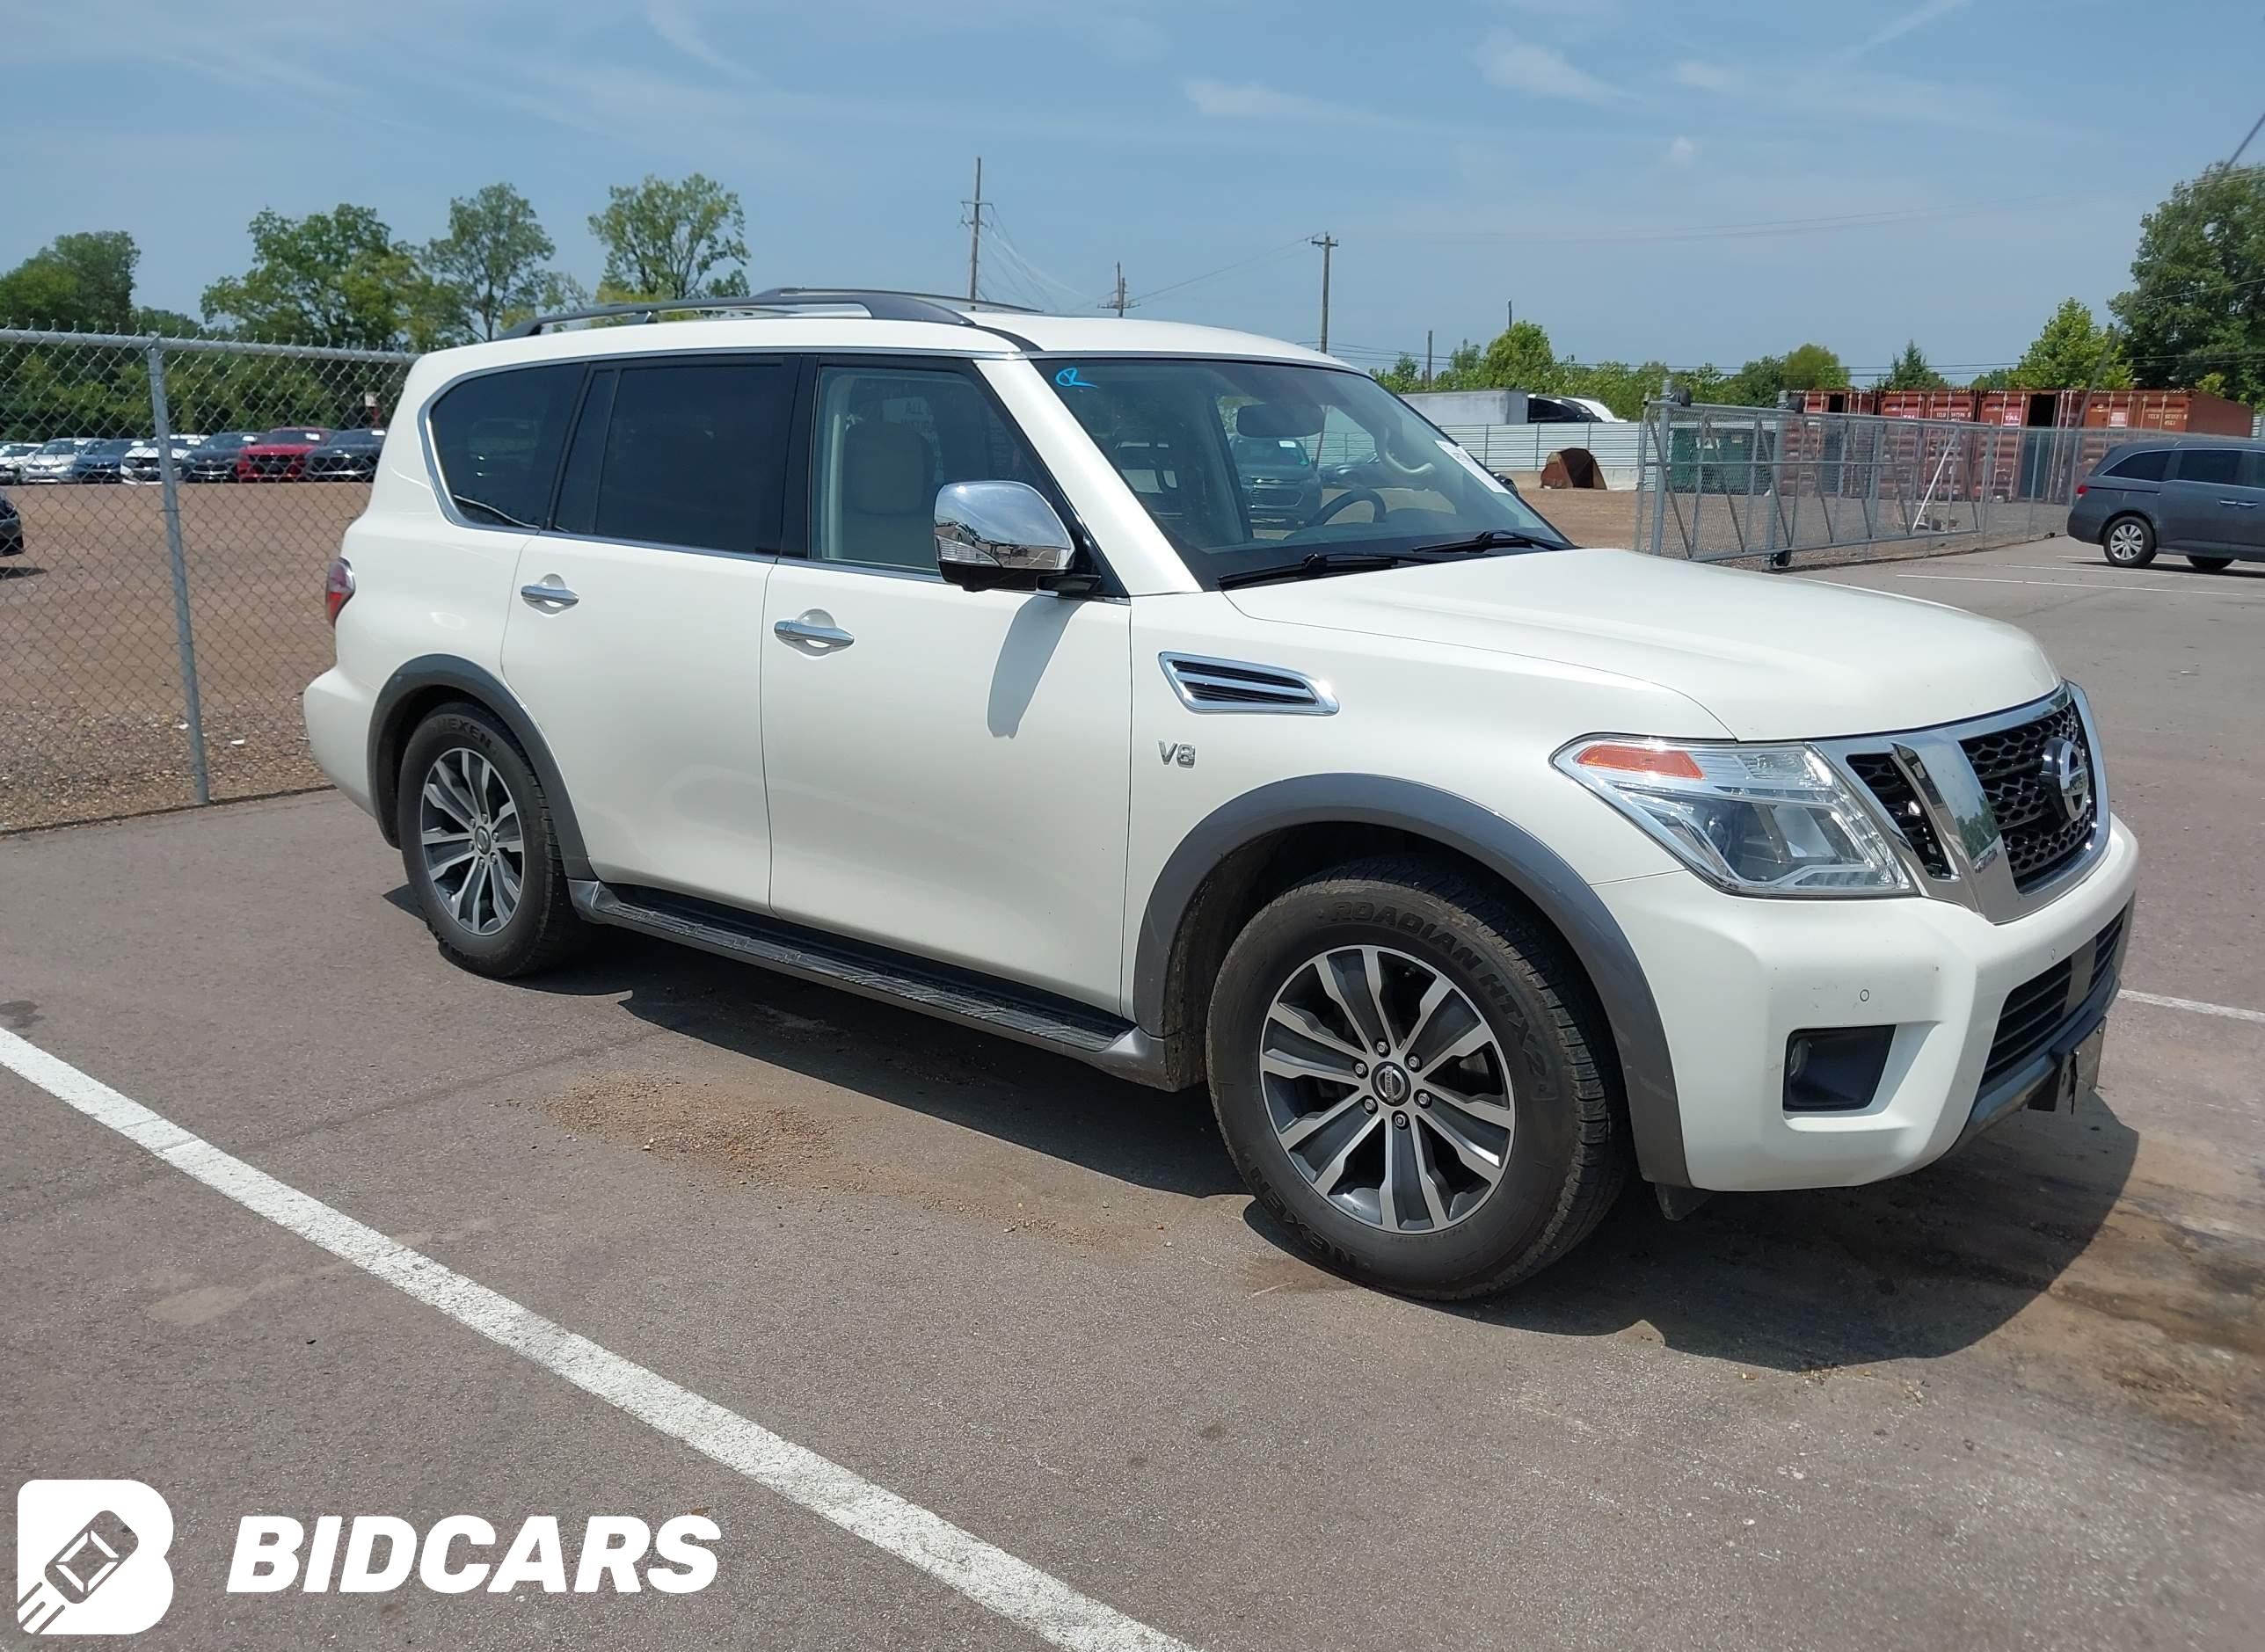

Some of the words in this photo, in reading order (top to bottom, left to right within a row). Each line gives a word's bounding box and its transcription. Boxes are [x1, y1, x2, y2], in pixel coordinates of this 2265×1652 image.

[1157, 740, 1196, 768] V8
[1331, 900, 1484, 972] ROADIAN
[1249, 1167, 1358, 1269] NEXEN
